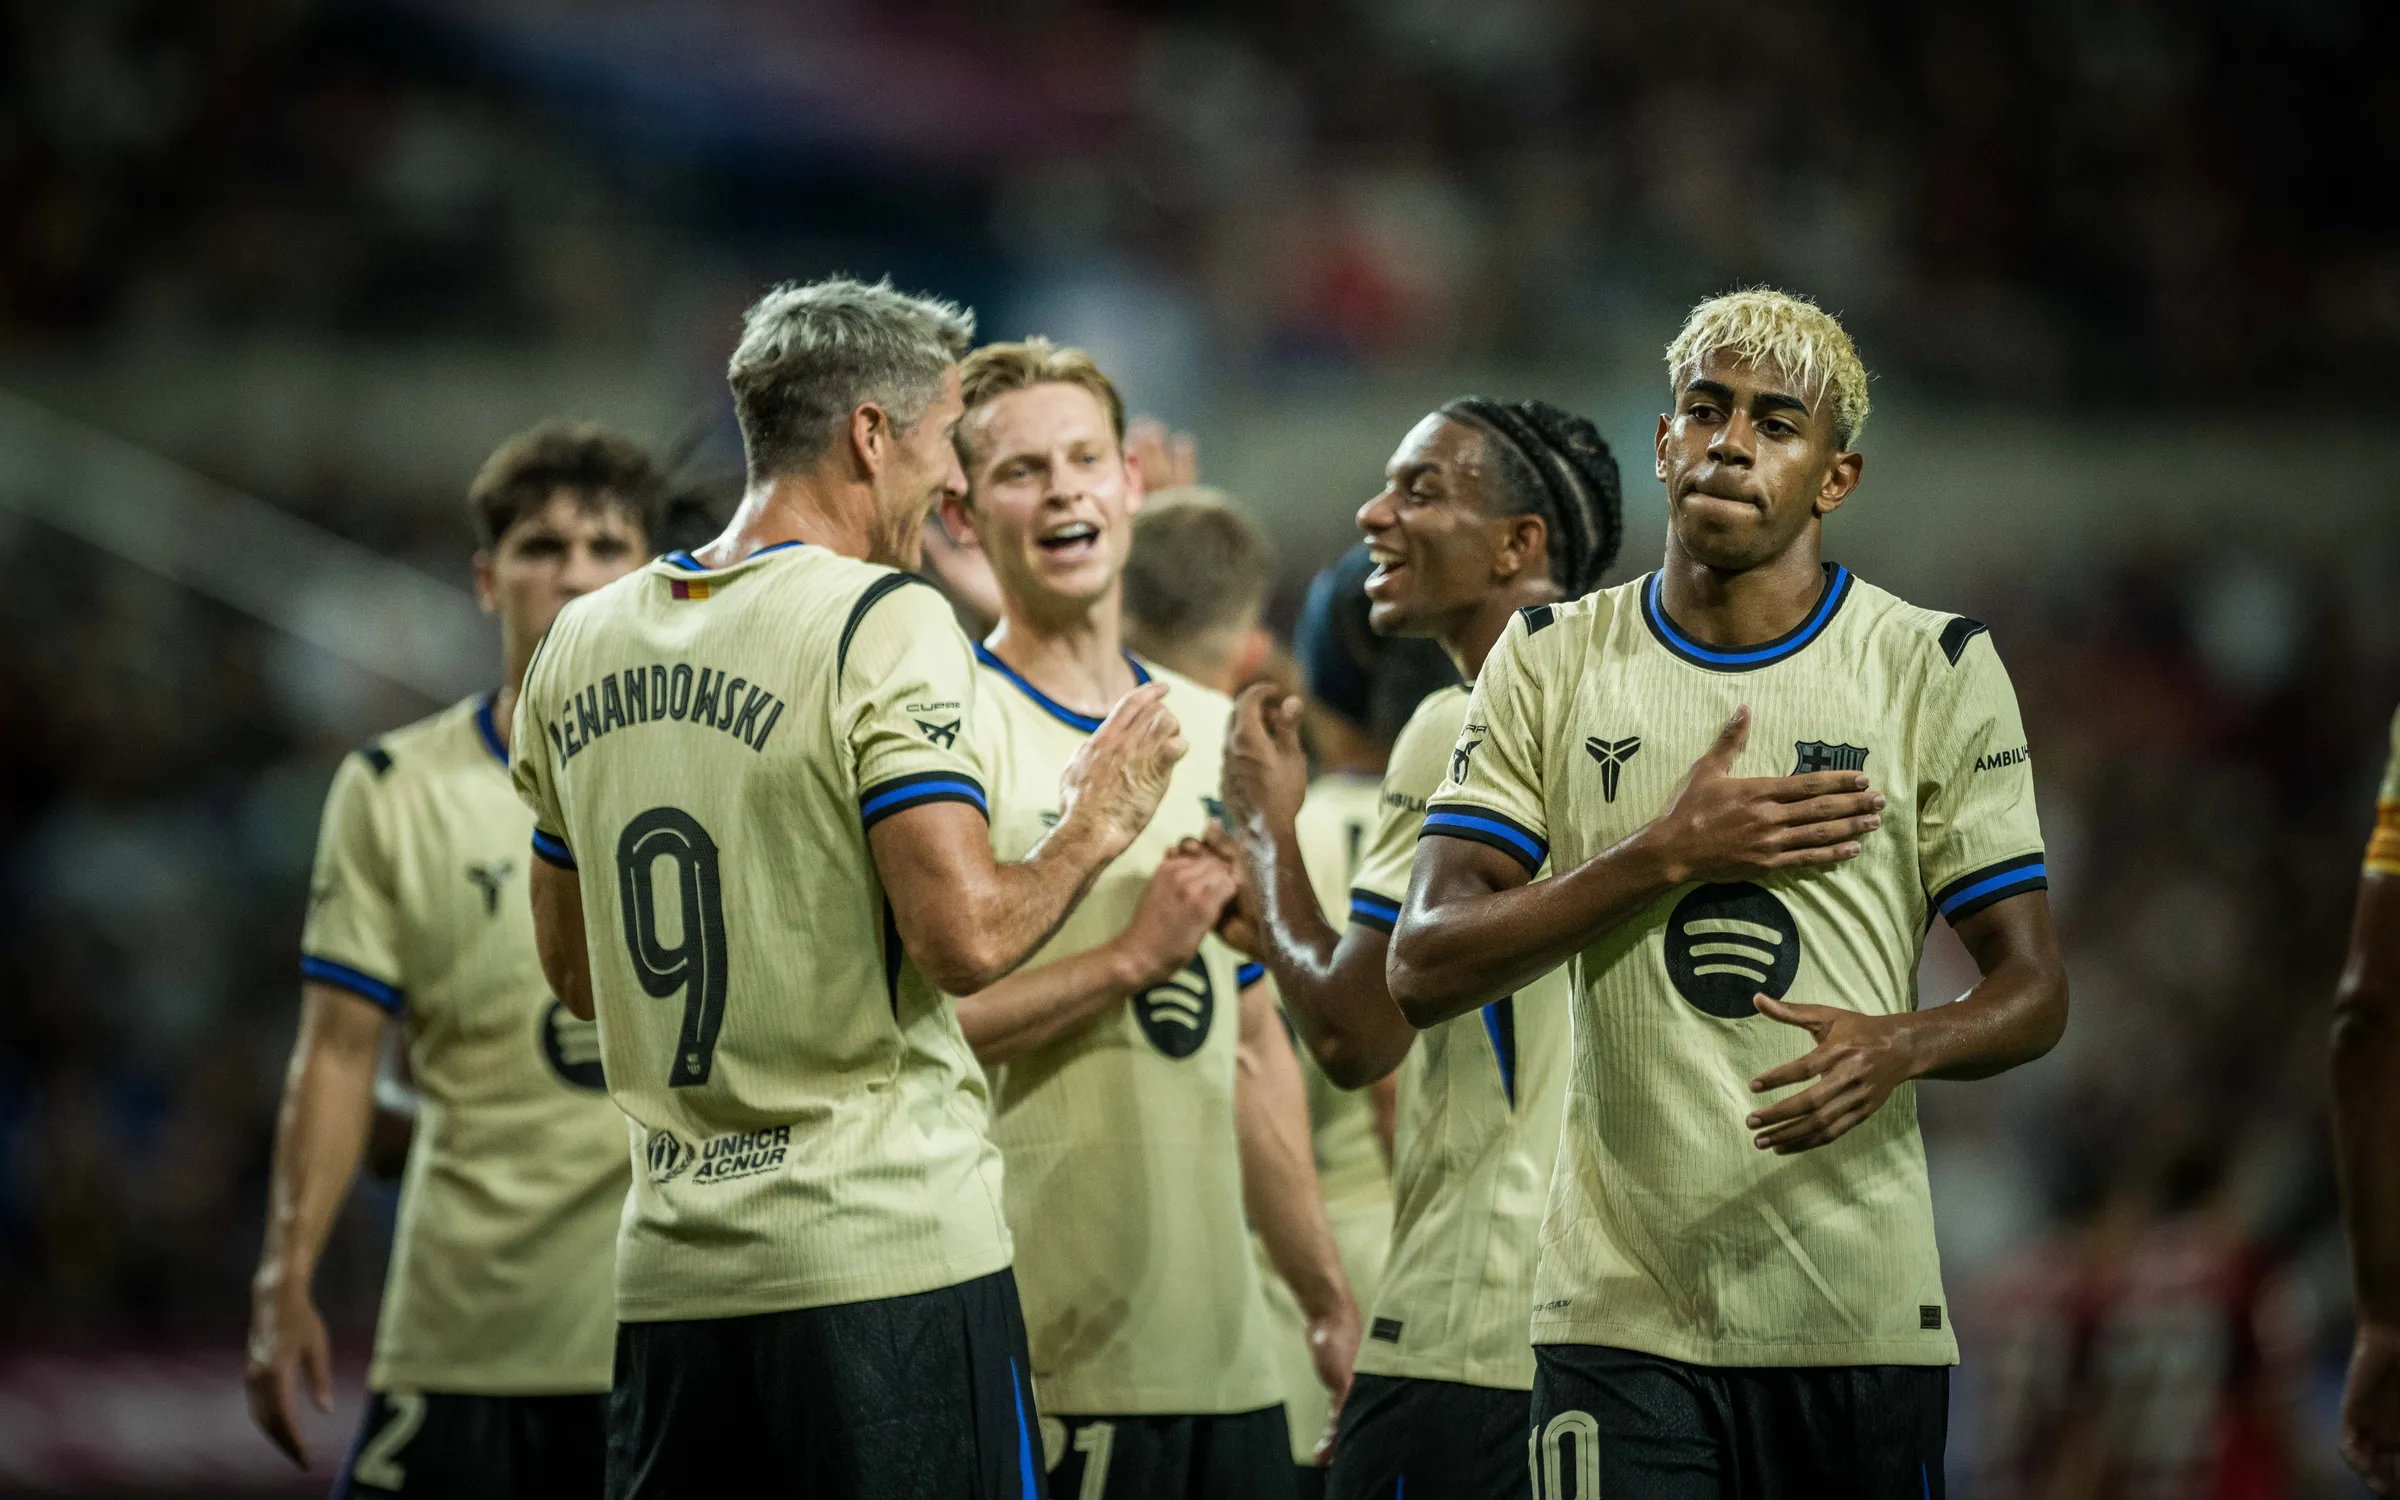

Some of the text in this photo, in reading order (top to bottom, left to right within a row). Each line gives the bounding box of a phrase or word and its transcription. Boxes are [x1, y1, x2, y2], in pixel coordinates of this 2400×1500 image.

[547, 663, 784, 770] LEWANDOWSKI
[616, 807, 728, 1088] 9
[694, 1147, 787, 1178] ACNUR
[703, 1124, 790, 1160] UNHCR
[354, 1392, 428, 1491] 2
